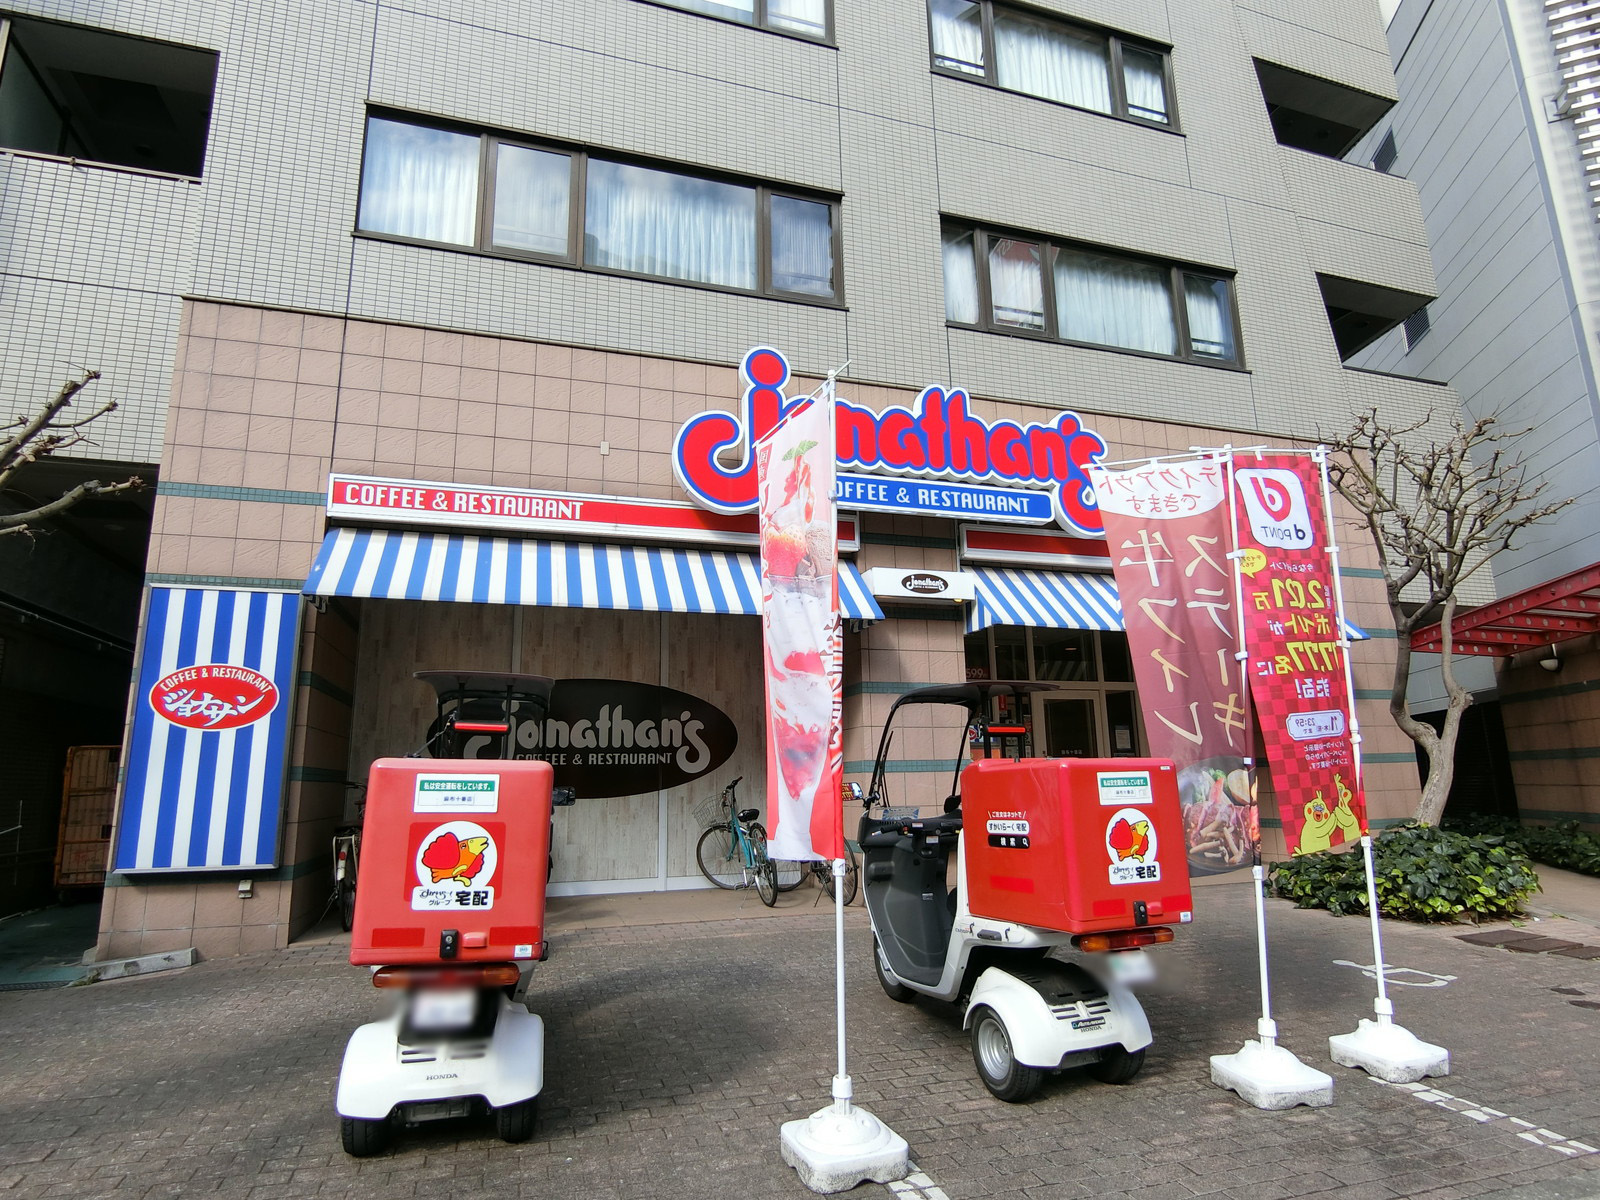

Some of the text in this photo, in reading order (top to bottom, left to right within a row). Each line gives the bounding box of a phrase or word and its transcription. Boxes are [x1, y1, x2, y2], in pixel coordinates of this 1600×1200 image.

[676, 348, 1103, 534] jnathan's
[345, 484, 584, 520] COFFEE & RESTAURANT
[837, 480, 1030, 514] OFFEE & RESTAURANT
[160, 667, 274, 693] COFFEE & RESTAURANT
[162, 688, 266, 727] ジョナサン
[572, 754, 583, 765] &
[588, 752, 672, 765] RESTAURANT
[1135, 865, 1157, 879] 宅配
[455, 890, 489, 906] 宅配
